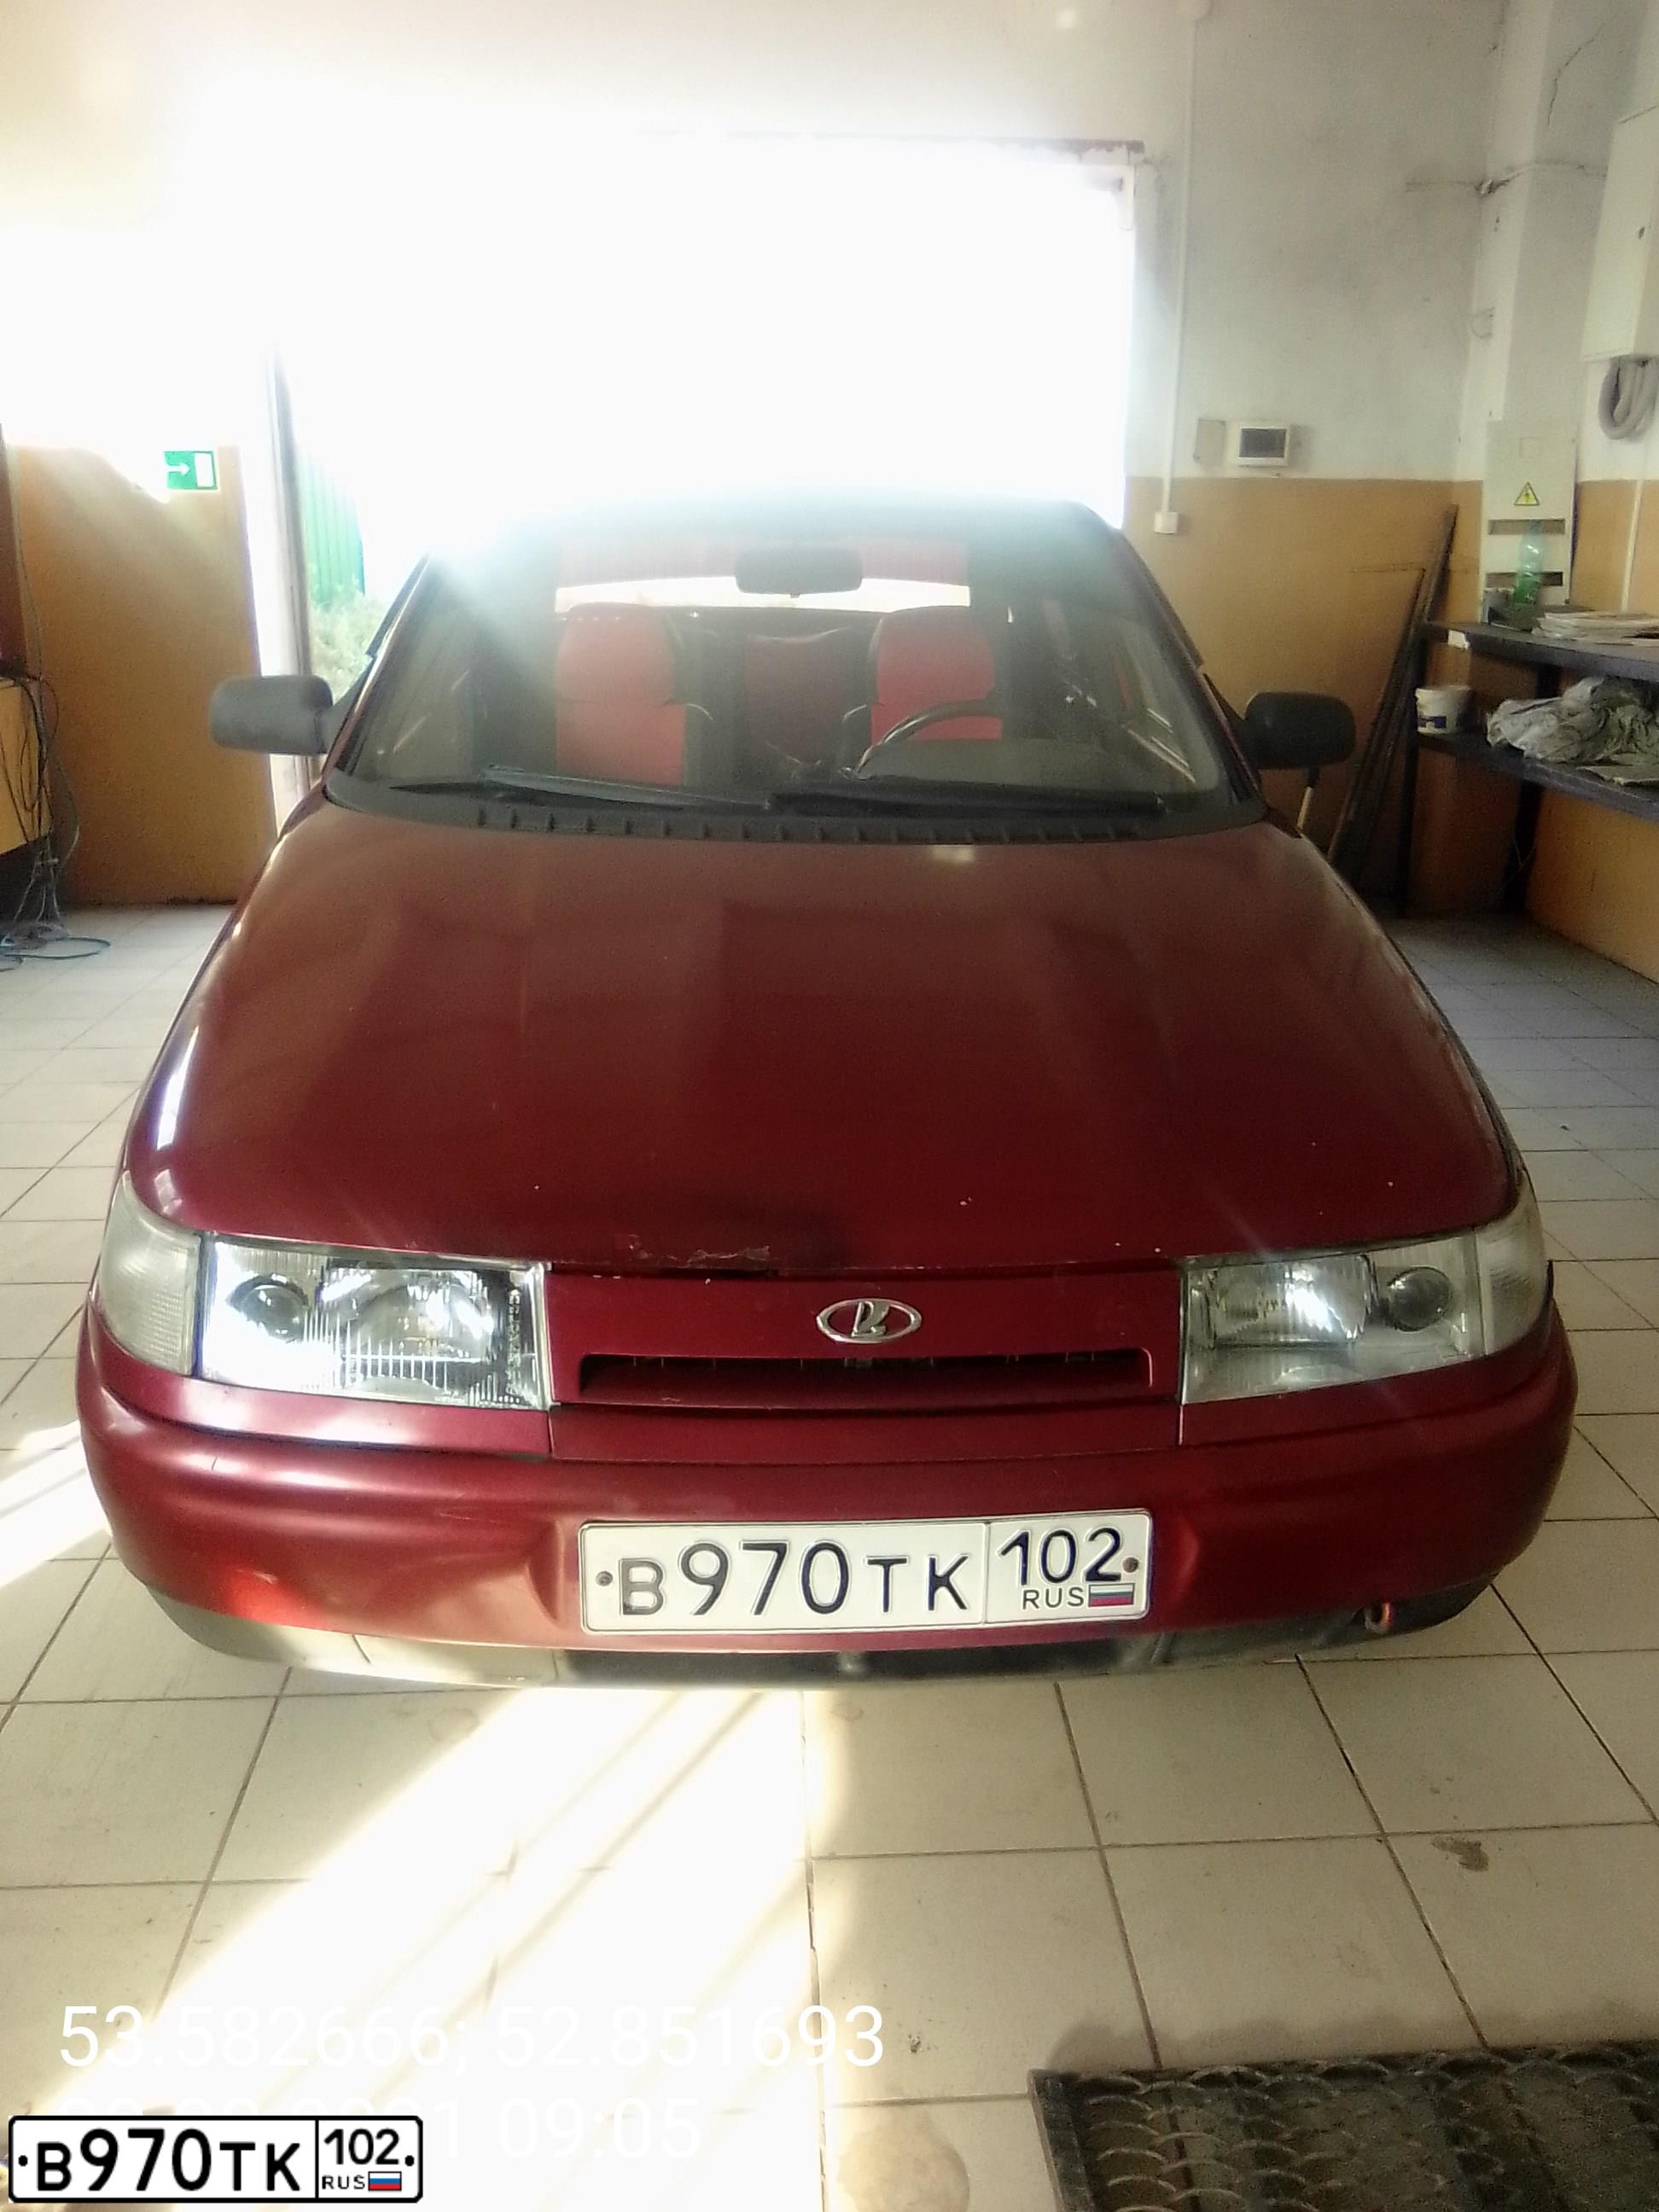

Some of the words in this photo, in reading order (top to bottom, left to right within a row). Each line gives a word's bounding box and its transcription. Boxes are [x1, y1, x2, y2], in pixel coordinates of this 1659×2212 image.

[619, 1540, 969, 1616] B970TK
[998, 1526, 1122, 1586] 102
[1022, 1586, 1085, 1610] RUS
